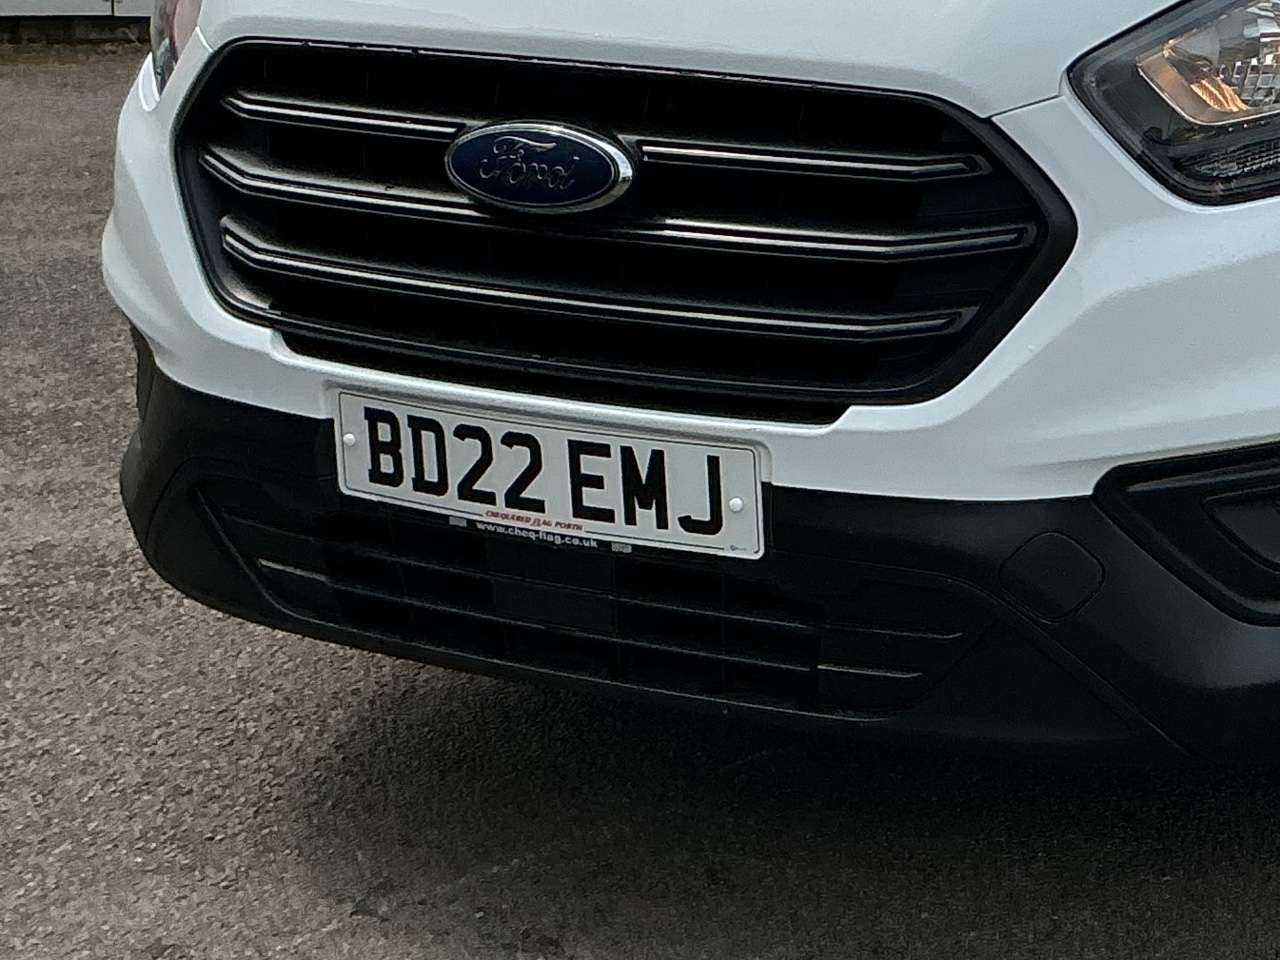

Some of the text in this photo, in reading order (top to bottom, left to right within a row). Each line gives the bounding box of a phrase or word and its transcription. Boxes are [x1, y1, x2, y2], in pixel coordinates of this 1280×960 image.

[479, 135, 580, 190] Ford
[364, 406, 723, 536] BD22 EMJ
